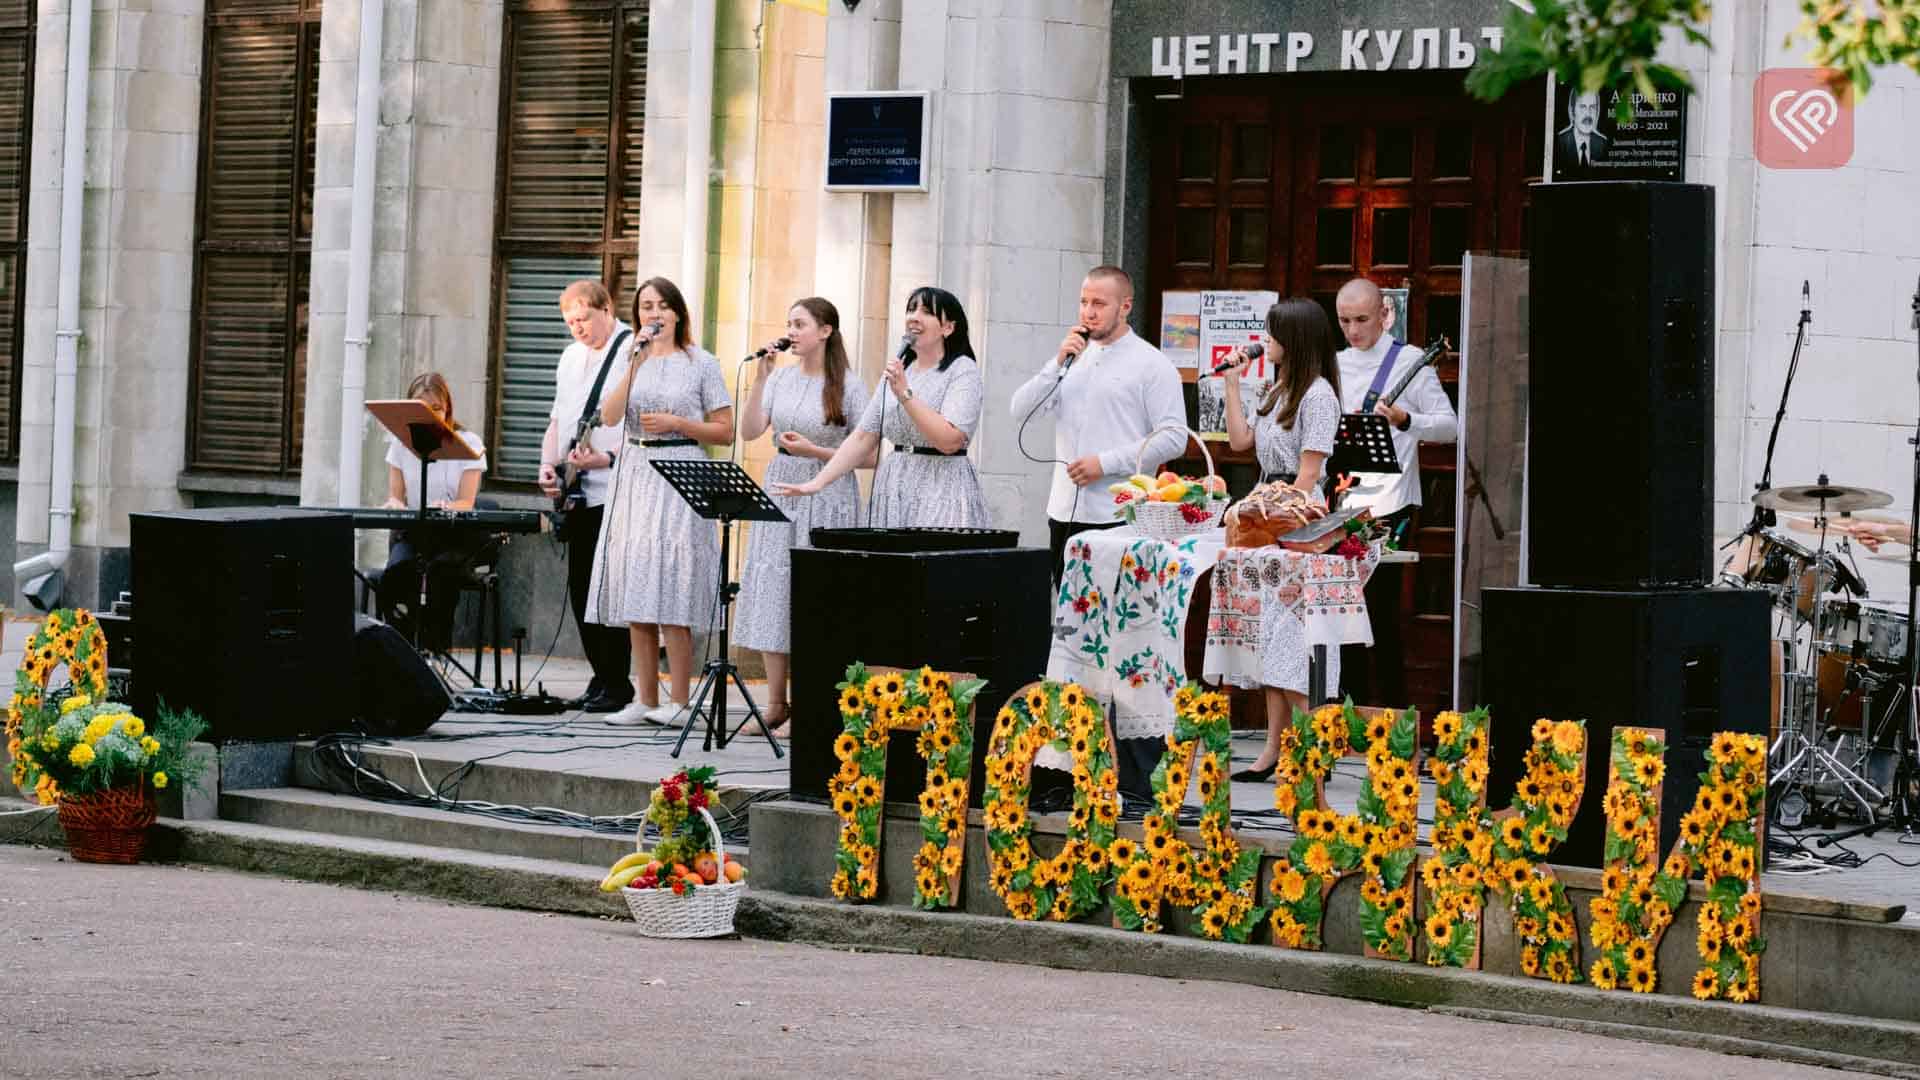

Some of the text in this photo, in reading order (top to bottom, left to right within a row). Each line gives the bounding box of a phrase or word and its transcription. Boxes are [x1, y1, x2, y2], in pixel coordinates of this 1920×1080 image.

[1151, 32, 1314, 79] ЦЕНТР
[1647, 121, 1669, 130] 2021
[1203, 294, 1216, 307] 22
[1247, 321, 1265, 329] РОКУ
[828, 662, 1767, 1003] ПОДЯКИ
